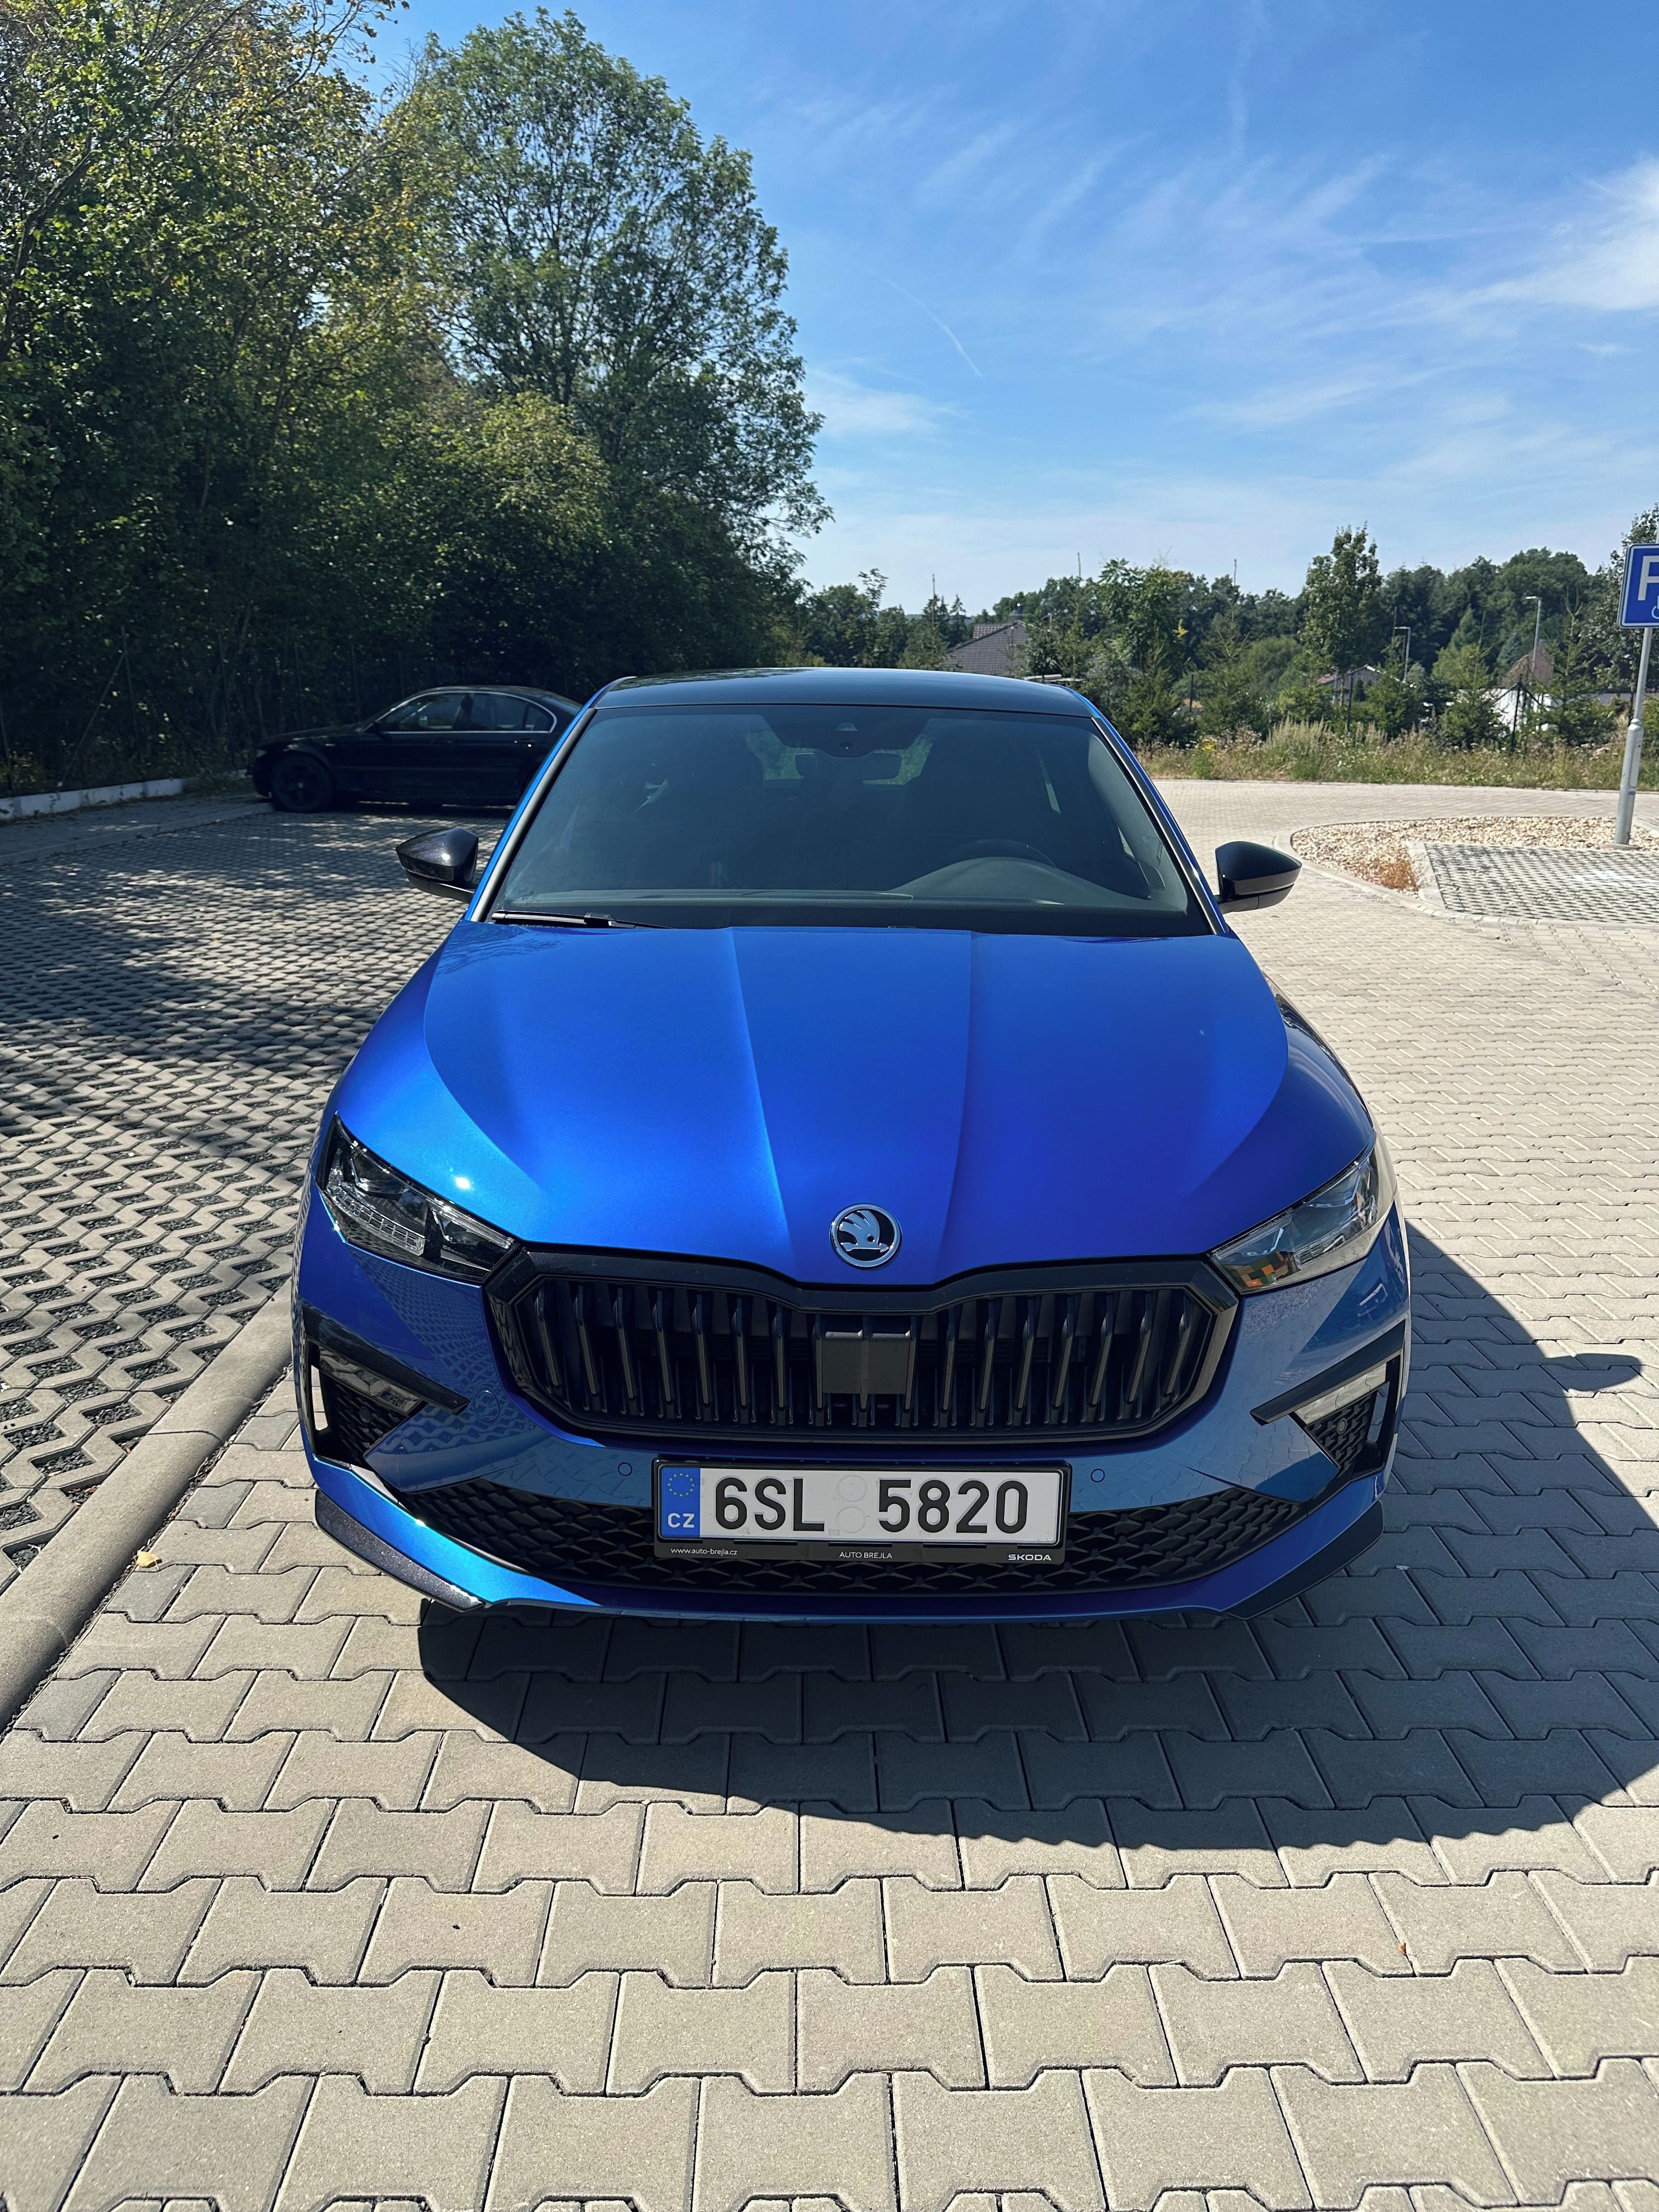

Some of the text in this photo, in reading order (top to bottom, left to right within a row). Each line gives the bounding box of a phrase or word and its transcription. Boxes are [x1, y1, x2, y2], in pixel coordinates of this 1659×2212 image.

[668, 1513, 695, 1528] CZ
[715, 1477, 1028, 1534] 6SL 5820
